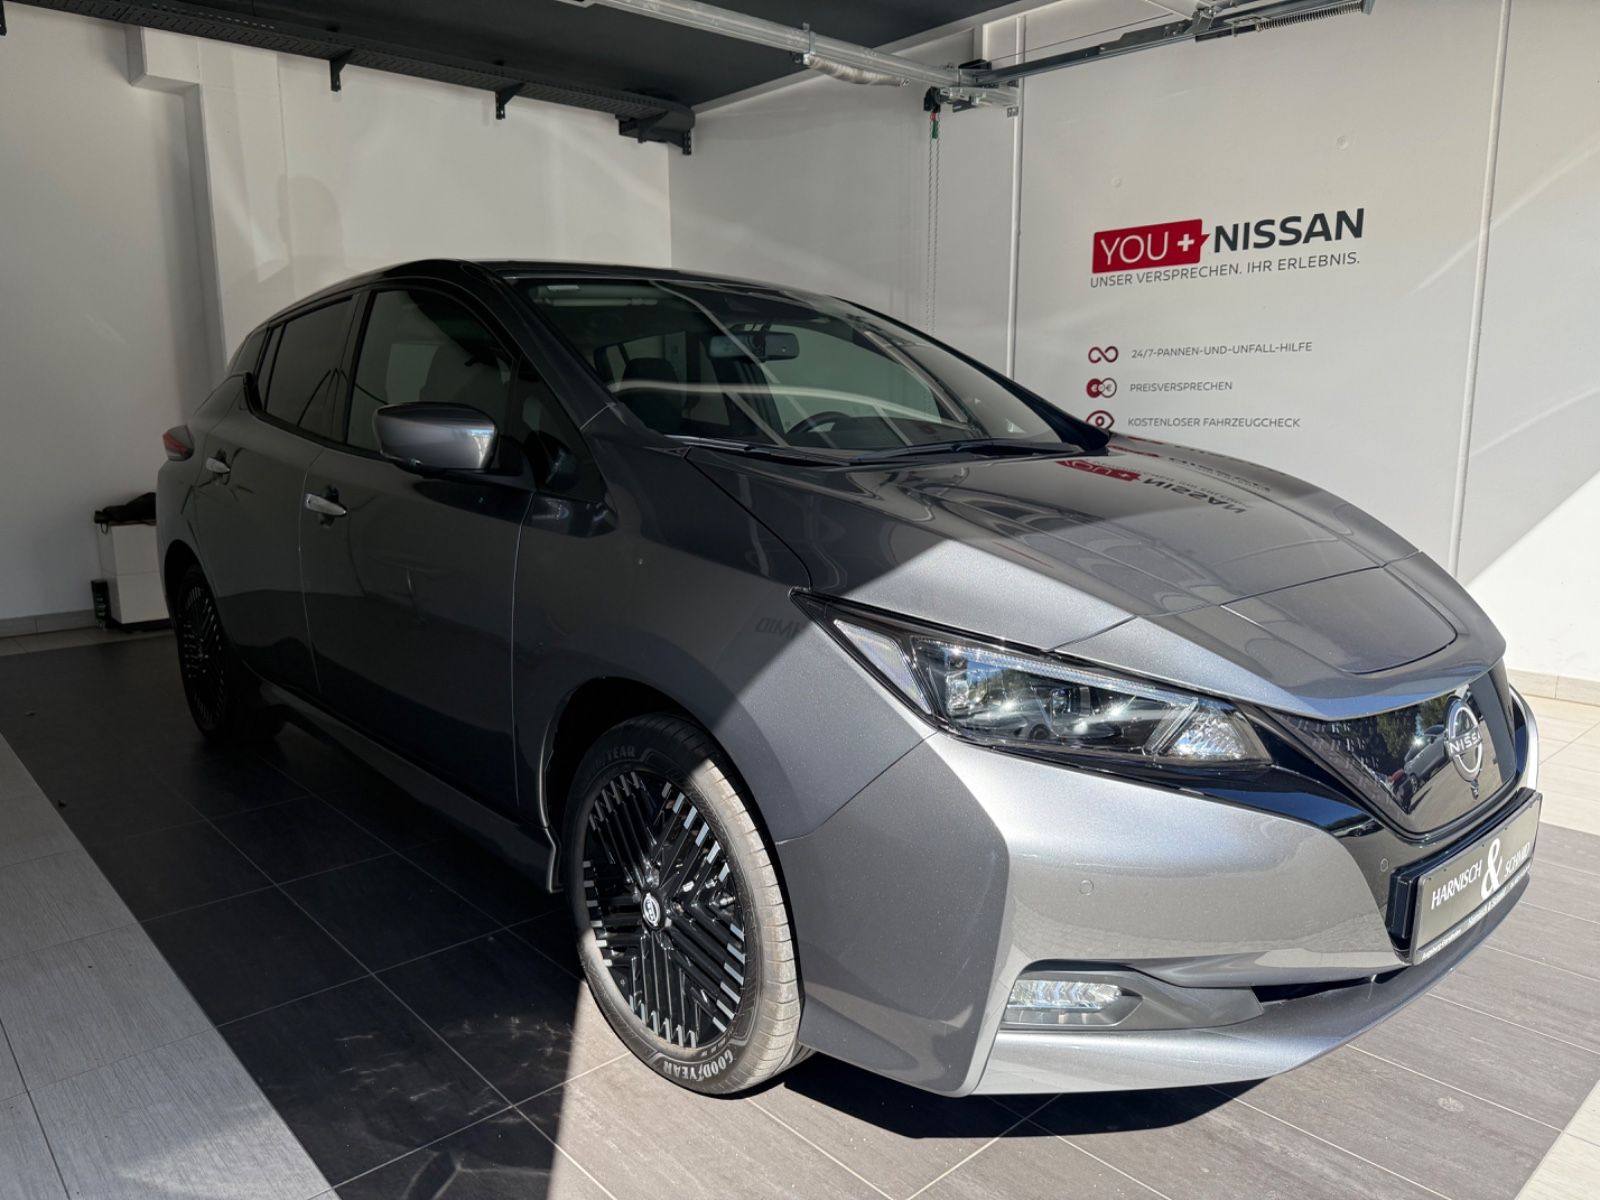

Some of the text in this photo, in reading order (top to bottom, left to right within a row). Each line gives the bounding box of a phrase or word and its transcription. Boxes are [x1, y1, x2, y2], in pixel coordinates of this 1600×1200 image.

[1100, 232, 1169, 265] YOU
[1214, 208, 1364, 253] NISSAN
[1090, 252, 1360, 288] UNSER VERSPRECHEN. IHR ERLEBNIS.
[1131, 342, 1312, 358] 24/7-PANNEN-UND-UNFALL-HILFE
[1130, 381, 1233, 392] PREISVERSPRECHEN
[1128, 417, 1300, 428] KOSTENLOSER FAHRZEUGCHECK
[1431, 859, 1482, 910] HARNISCH
[1481, 838, 1502, 900] &
[663, 1049, 733, 1081] GOODYEAR
